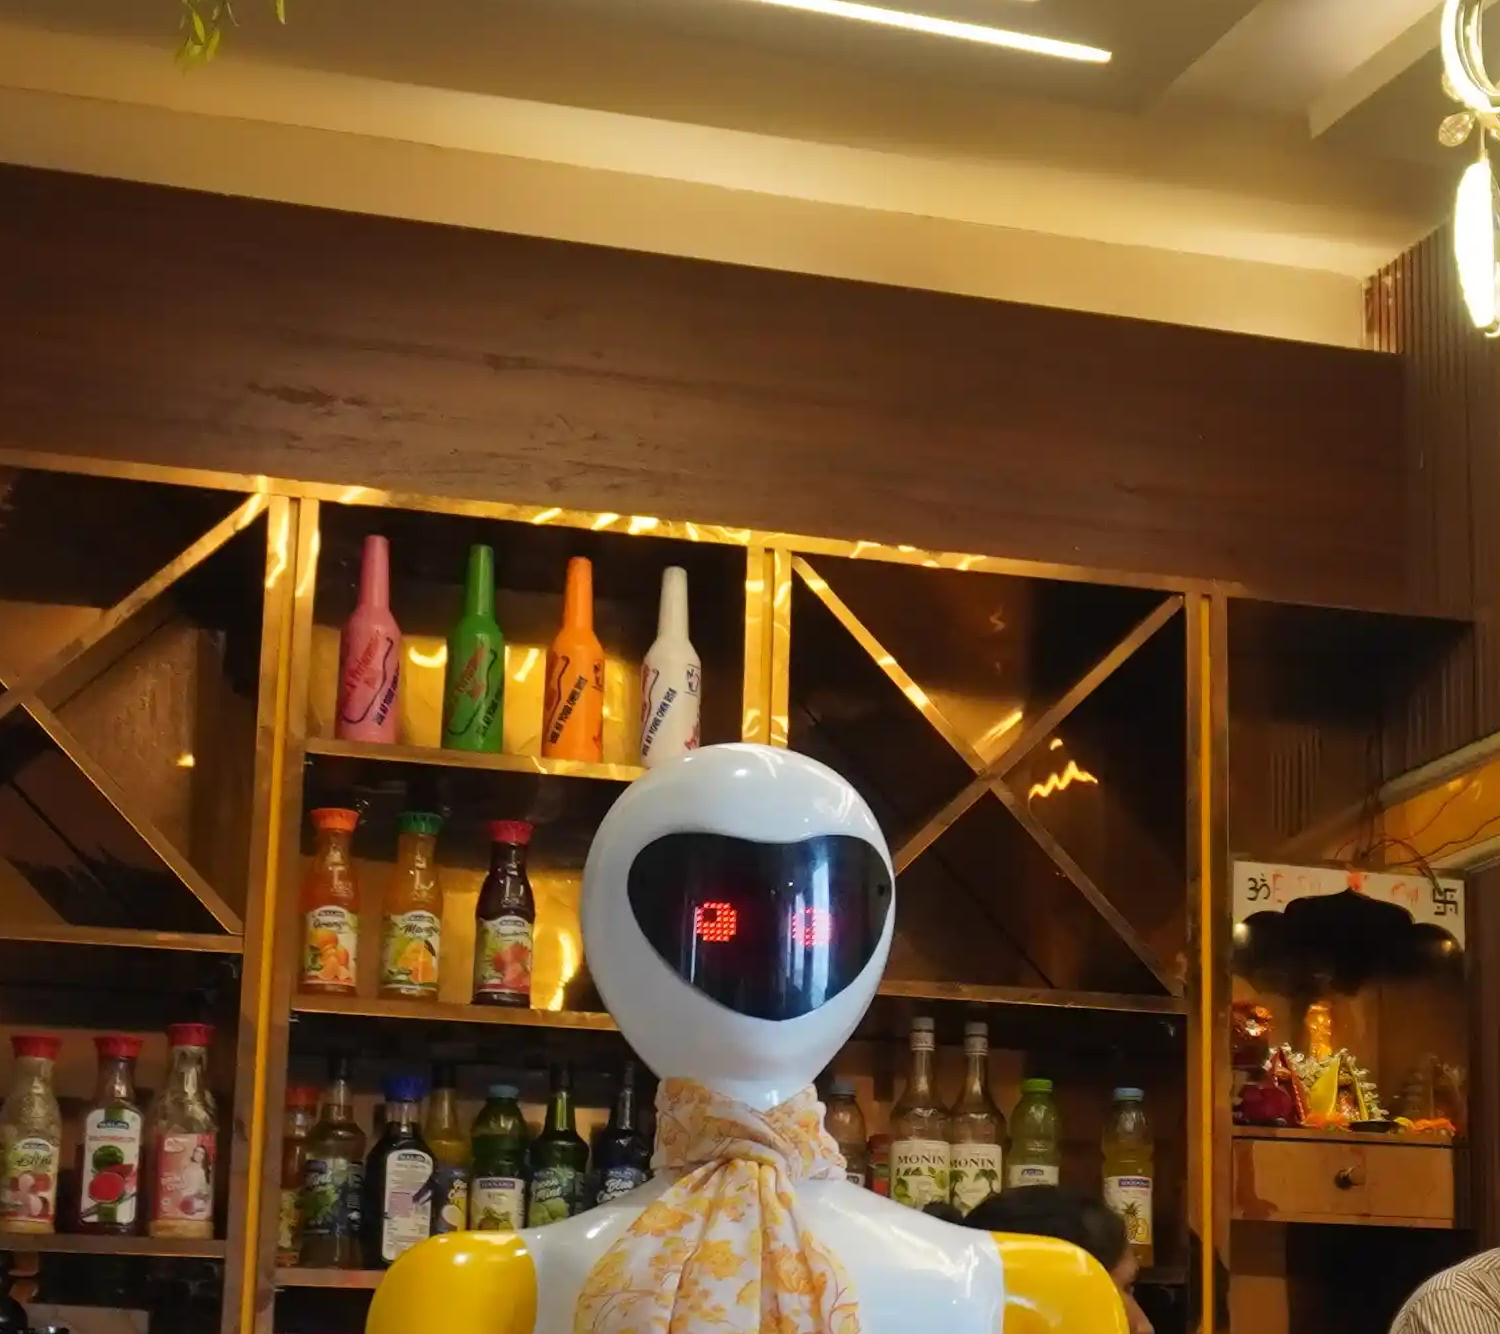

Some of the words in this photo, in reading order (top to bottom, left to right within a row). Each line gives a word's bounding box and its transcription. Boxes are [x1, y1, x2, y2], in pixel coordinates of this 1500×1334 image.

[898, 1155, 945, 1165] MONIN
[950, 1158, 995, 1169] MONIN
[605, 1177, 635, 1192] Blue
